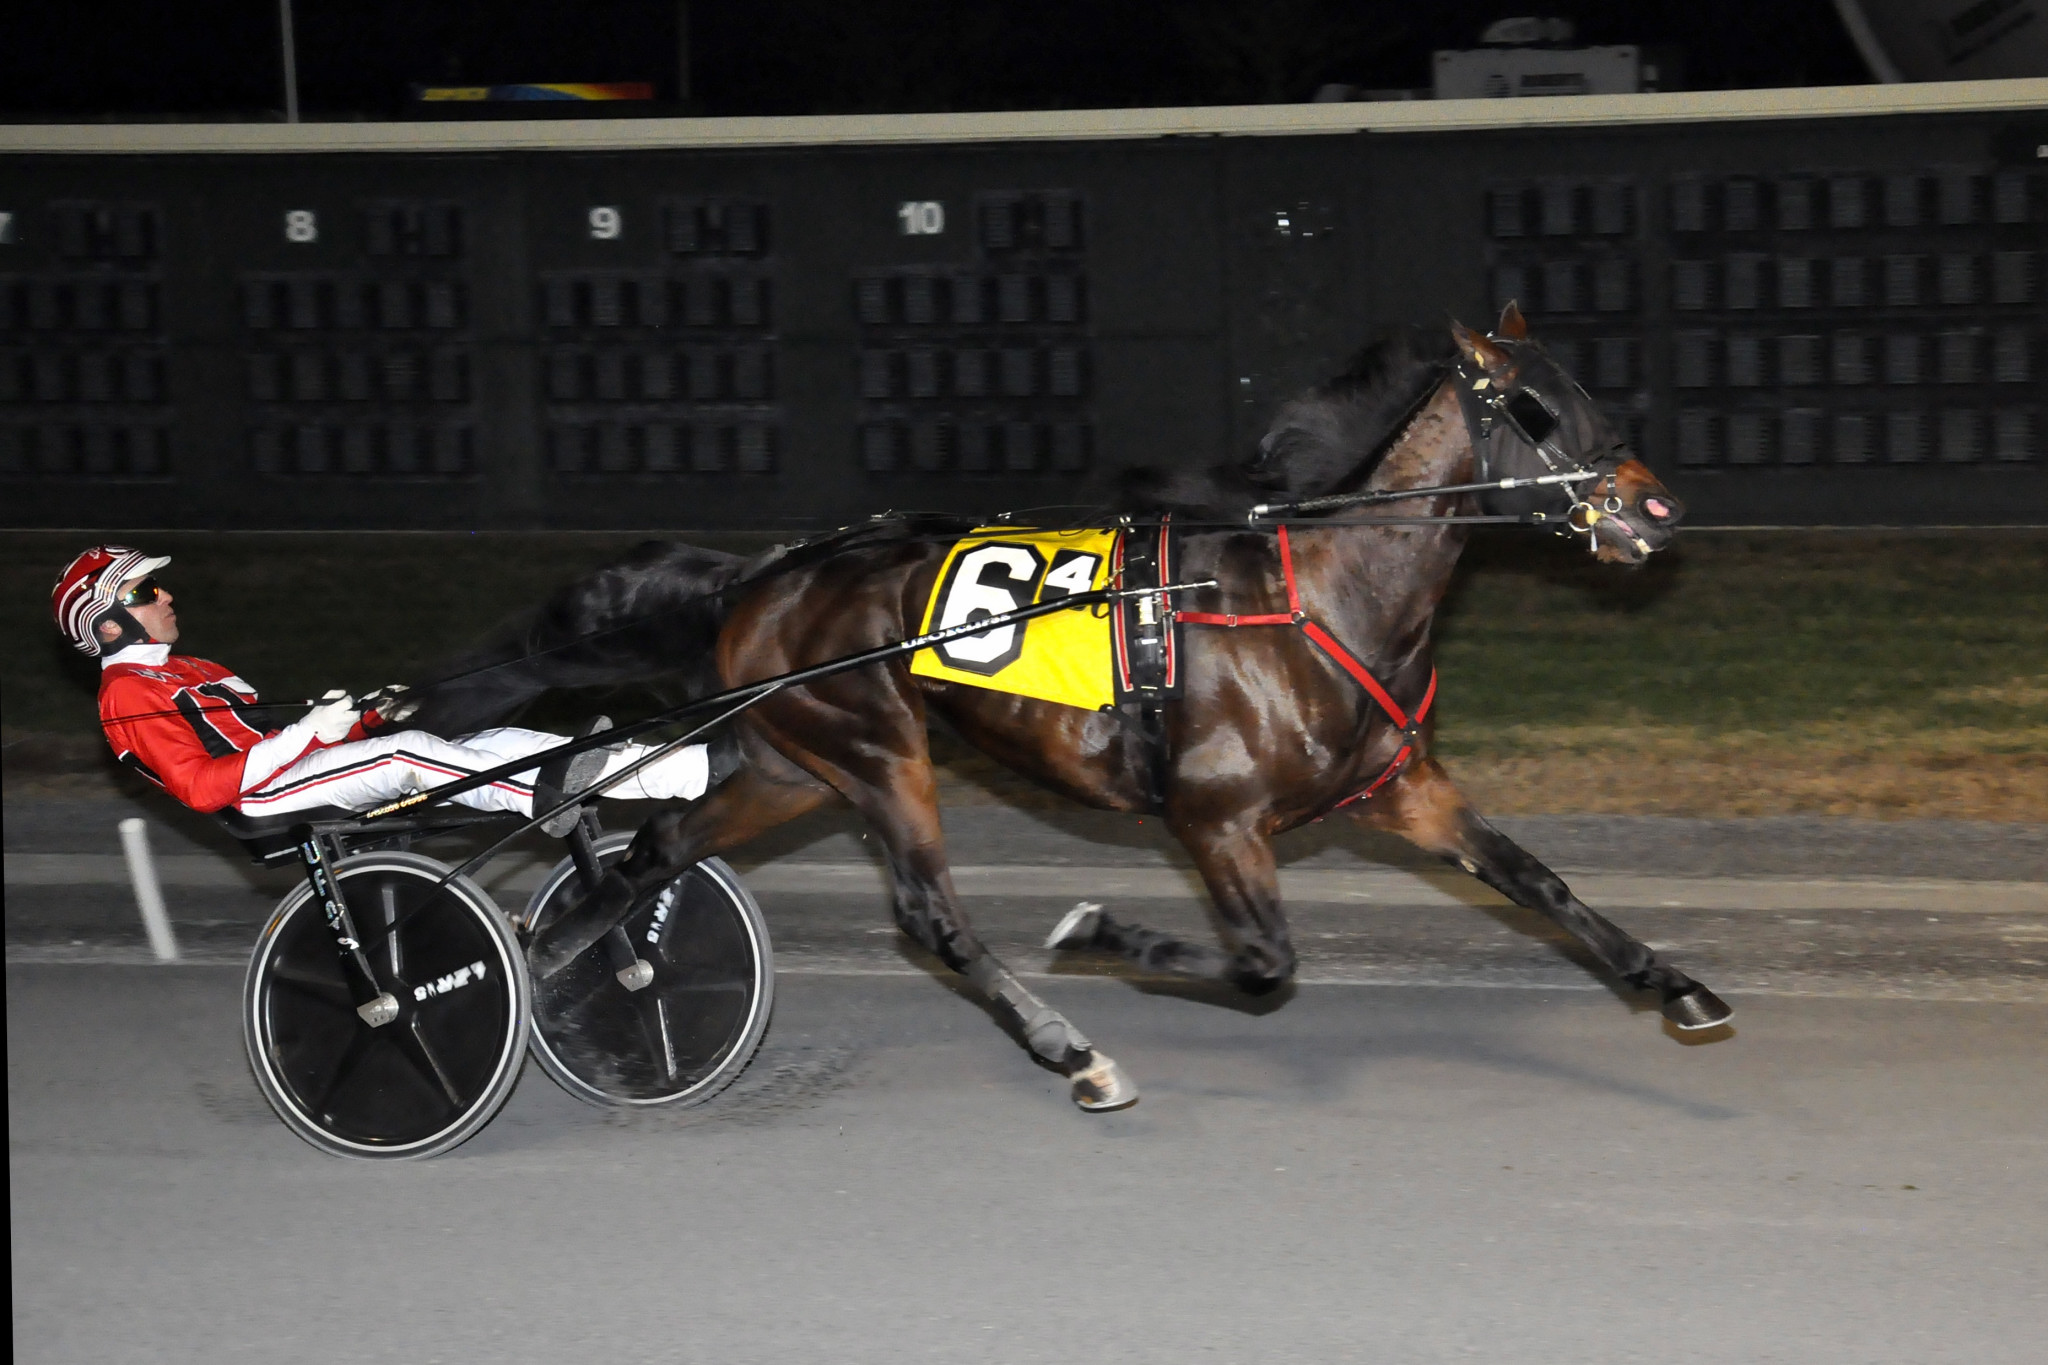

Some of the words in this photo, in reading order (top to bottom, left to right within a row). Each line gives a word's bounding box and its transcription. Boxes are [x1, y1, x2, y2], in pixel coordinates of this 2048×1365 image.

[287, 210, 316, 242] 8
[590, 207, 620, 239] 9
[899, 201, 945, 234] 10
[937, 545, 1039, 665] 6
[1045, 555, 1097, 597] 4
